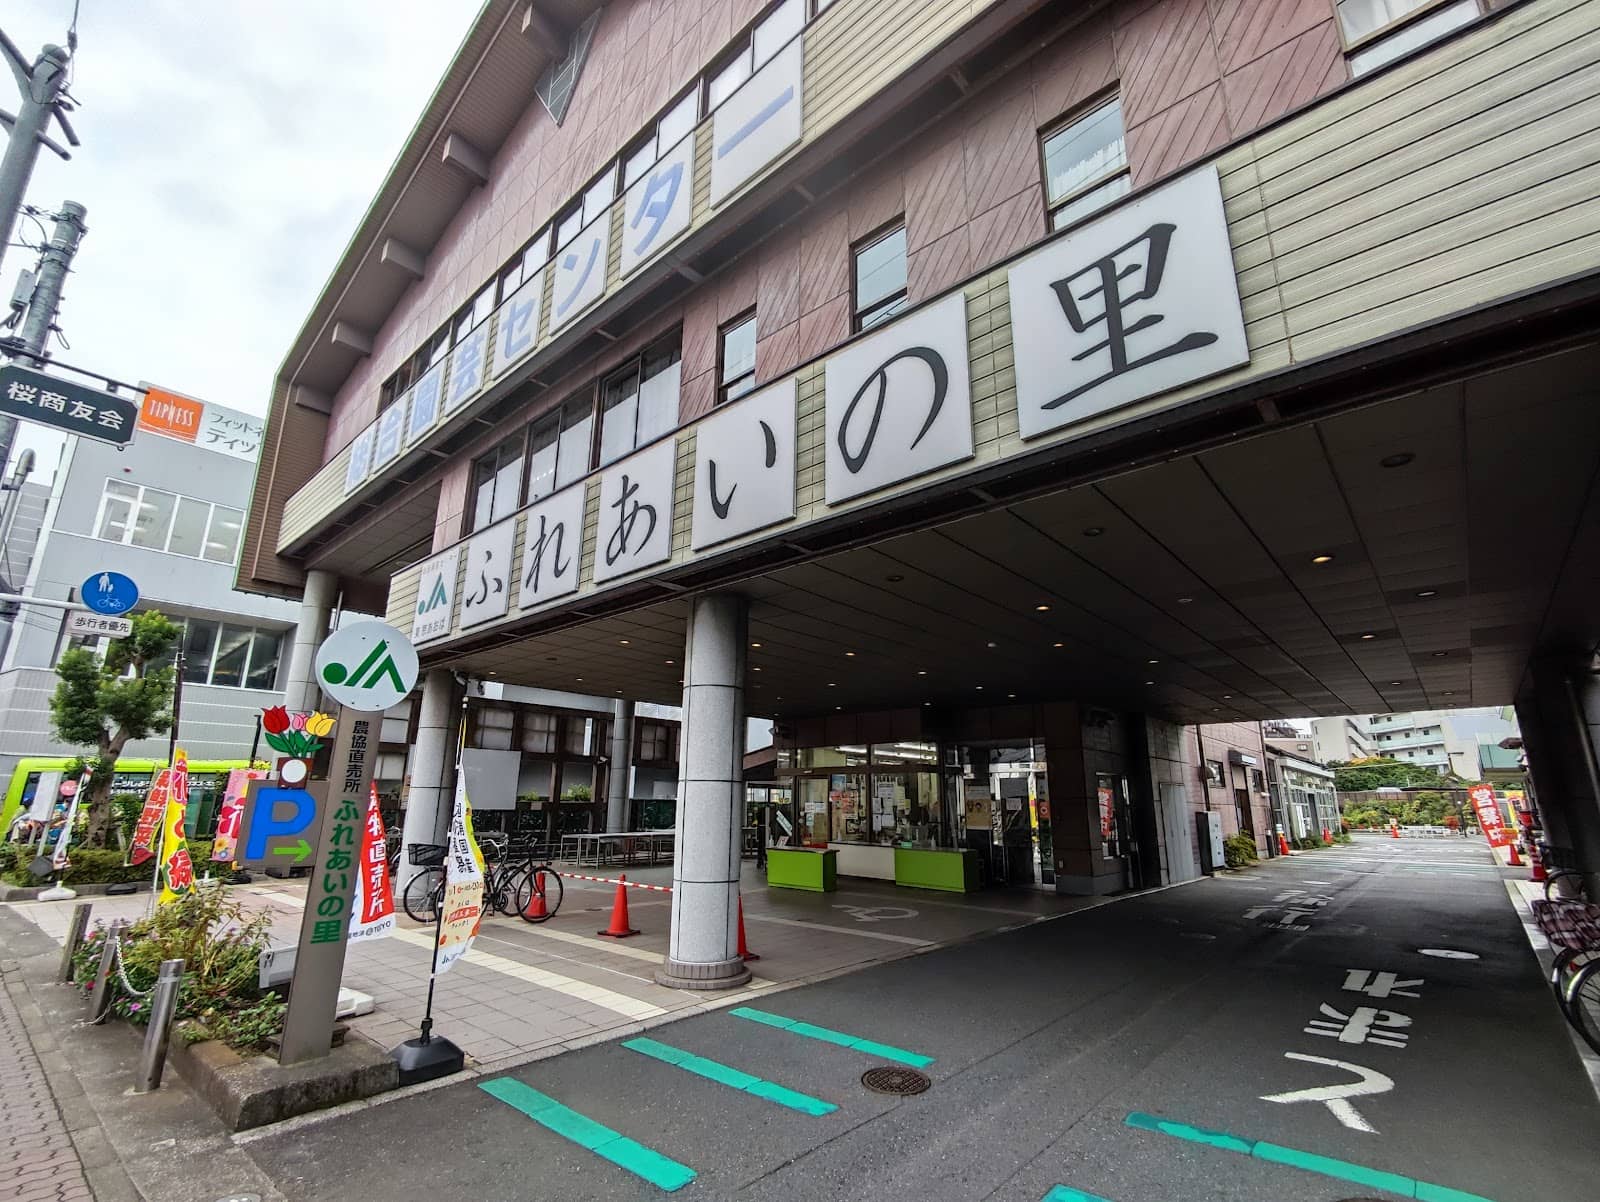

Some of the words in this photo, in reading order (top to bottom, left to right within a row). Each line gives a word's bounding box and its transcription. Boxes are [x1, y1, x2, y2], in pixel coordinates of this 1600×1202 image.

[7, 382, 124, 430] 桜商友会
[149, 399, 195, 427] TIPNESS
[466, 223, 1218, 608] ふれあいの里
[206, 427, 261, 453] ティッ
[74, 617, 129, 632] 歩行者優先
[323, 639, 407, 693] JA
[343, 720, 369, 793] 農協直売所
[245, 787, 316, 860] P
[1472, 789, 1504, 843] 営業中
[310, 800, 360, 944] ふれあいの里
